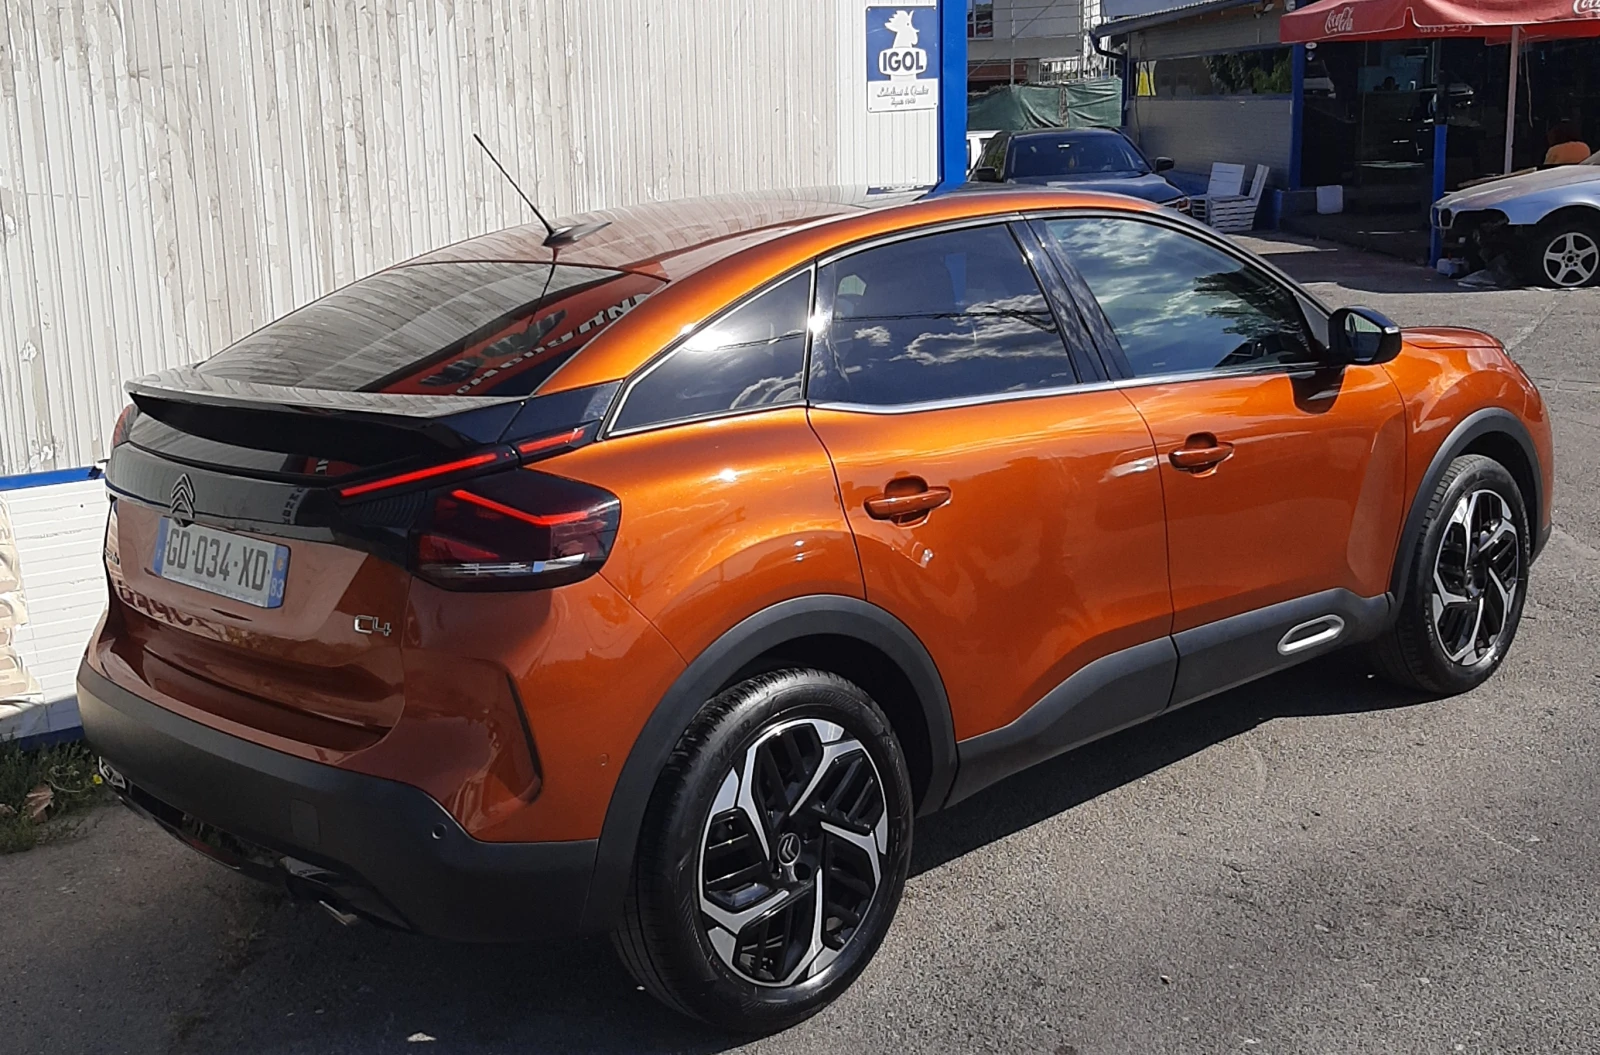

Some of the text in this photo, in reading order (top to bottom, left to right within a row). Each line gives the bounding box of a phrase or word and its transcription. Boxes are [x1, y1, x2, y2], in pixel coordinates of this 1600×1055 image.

[883, 51, 924, 72] IGOL
[270, 577, 285, 598] 83
[354, 615, 392, 637] C4
